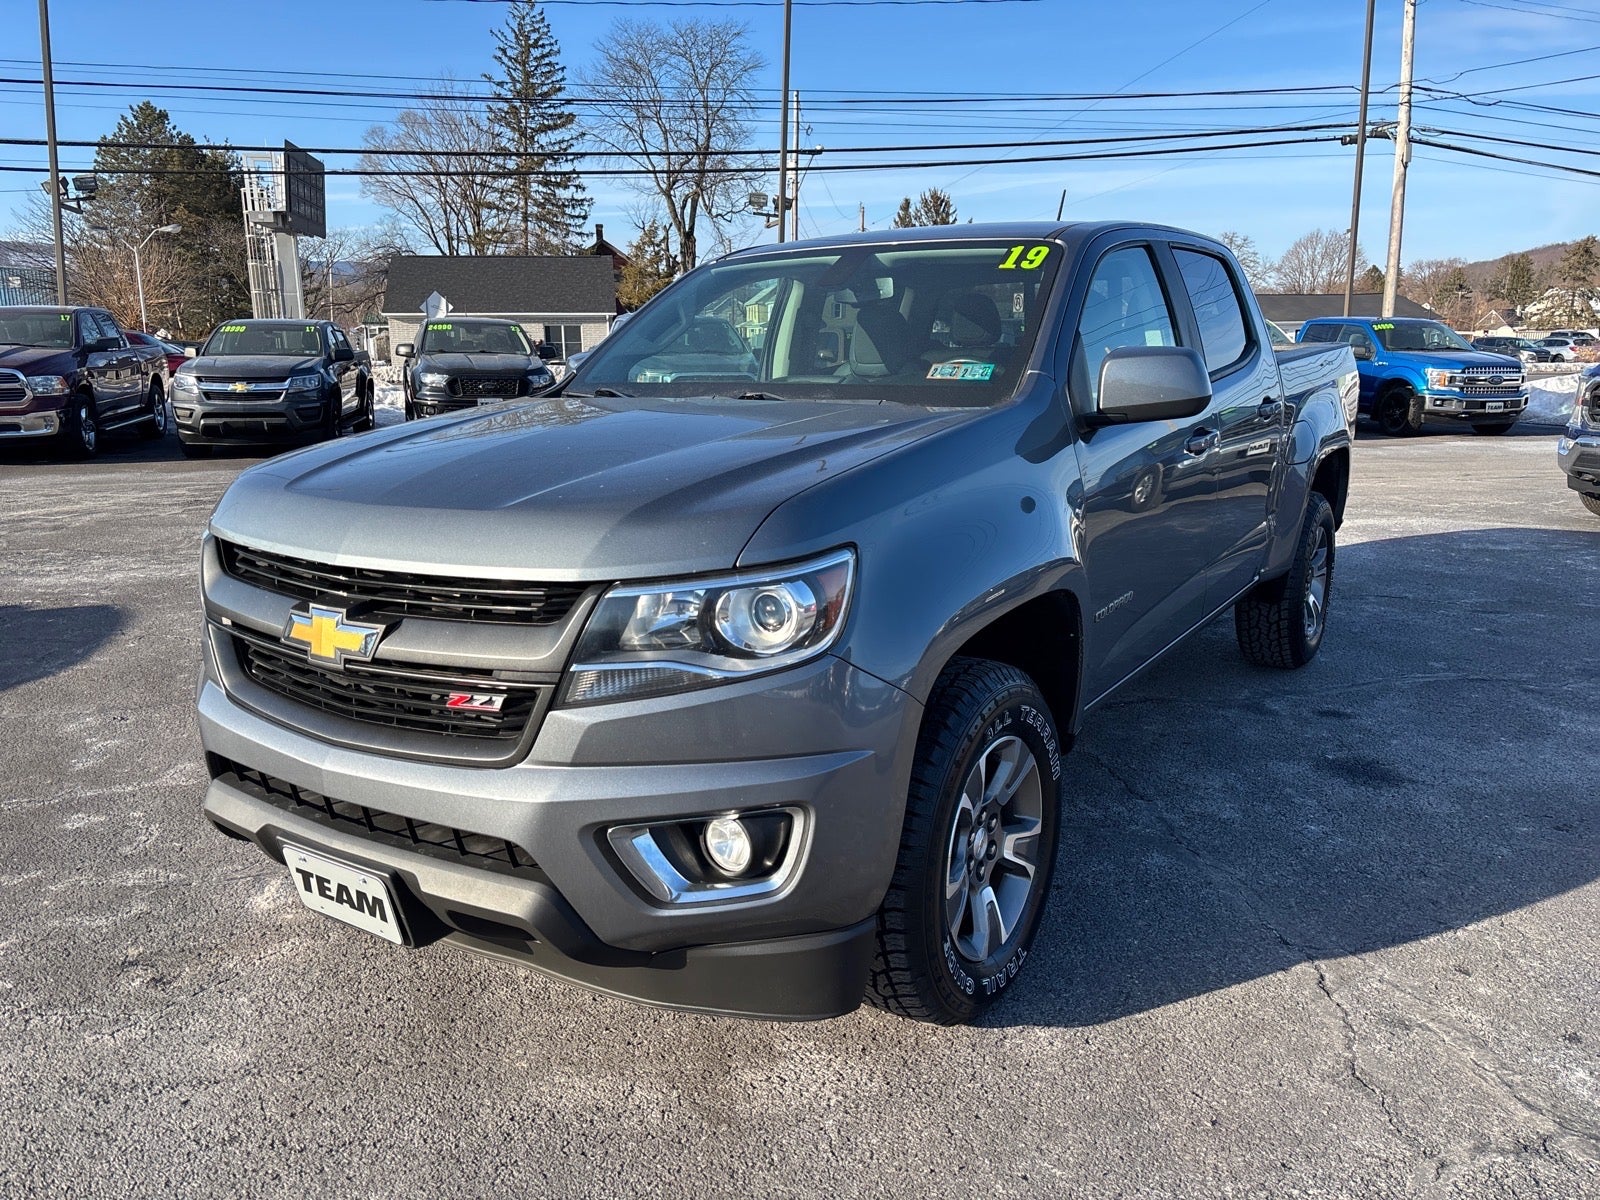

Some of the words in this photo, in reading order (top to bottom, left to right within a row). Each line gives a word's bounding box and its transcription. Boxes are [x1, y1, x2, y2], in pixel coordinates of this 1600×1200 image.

[998, 245, 1050, 269] 19
[1094, 590, 1134, 622] COLORADO
[446, 692, 507, 712] Z71
[1020, 704, 1061, 781] TERRAIN
[295, 867, 389, 924] TEAM
[982, 947, 1027, 995] TRAIL
